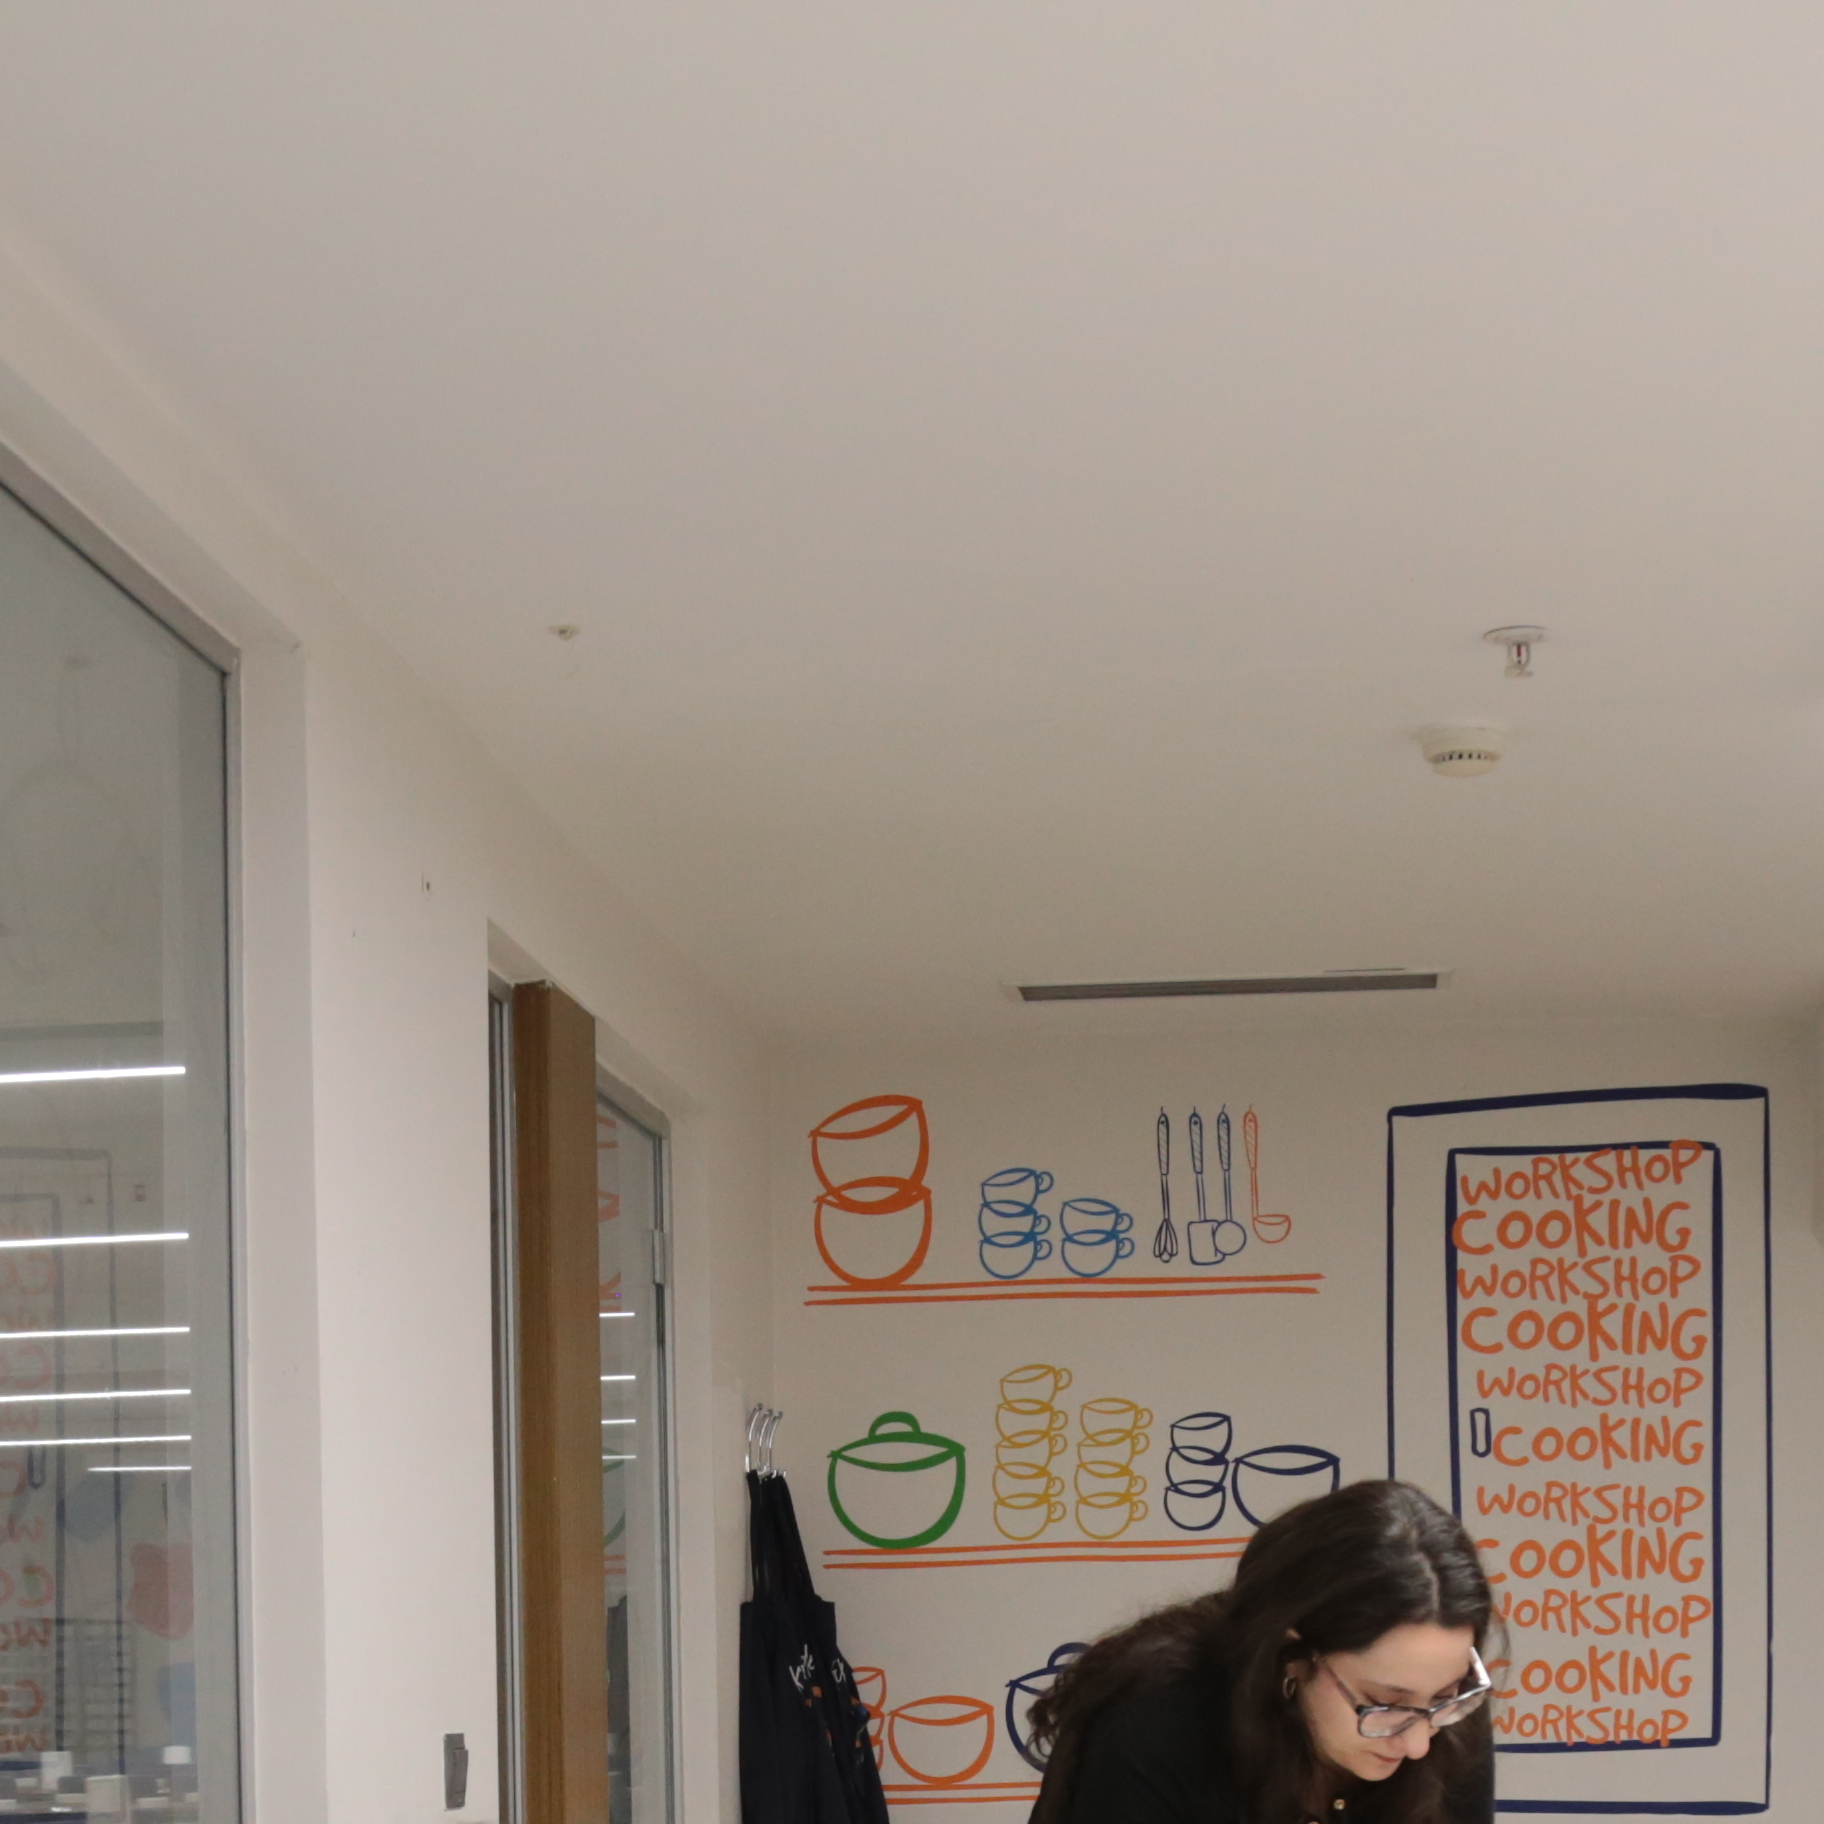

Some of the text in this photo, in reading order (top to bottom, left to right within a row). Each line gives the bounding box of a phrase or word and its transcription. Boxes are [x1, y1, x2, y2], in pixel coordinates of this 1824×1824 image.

[1461, 1139, 1703, 1206] WORKSHOP
[1452, 1193, 1692, 1258] COOKING
[1457, 1254, 1702, 1304] WORKSHOP
[1461, 1299, 1709, 1362] COOKING
[1477, 1362, 1704, 1409] WORKSHOP
[1493, 1412, 1705, 1470] COOKING
[1477, 1480, 1705, 1527] WORKSHOP
